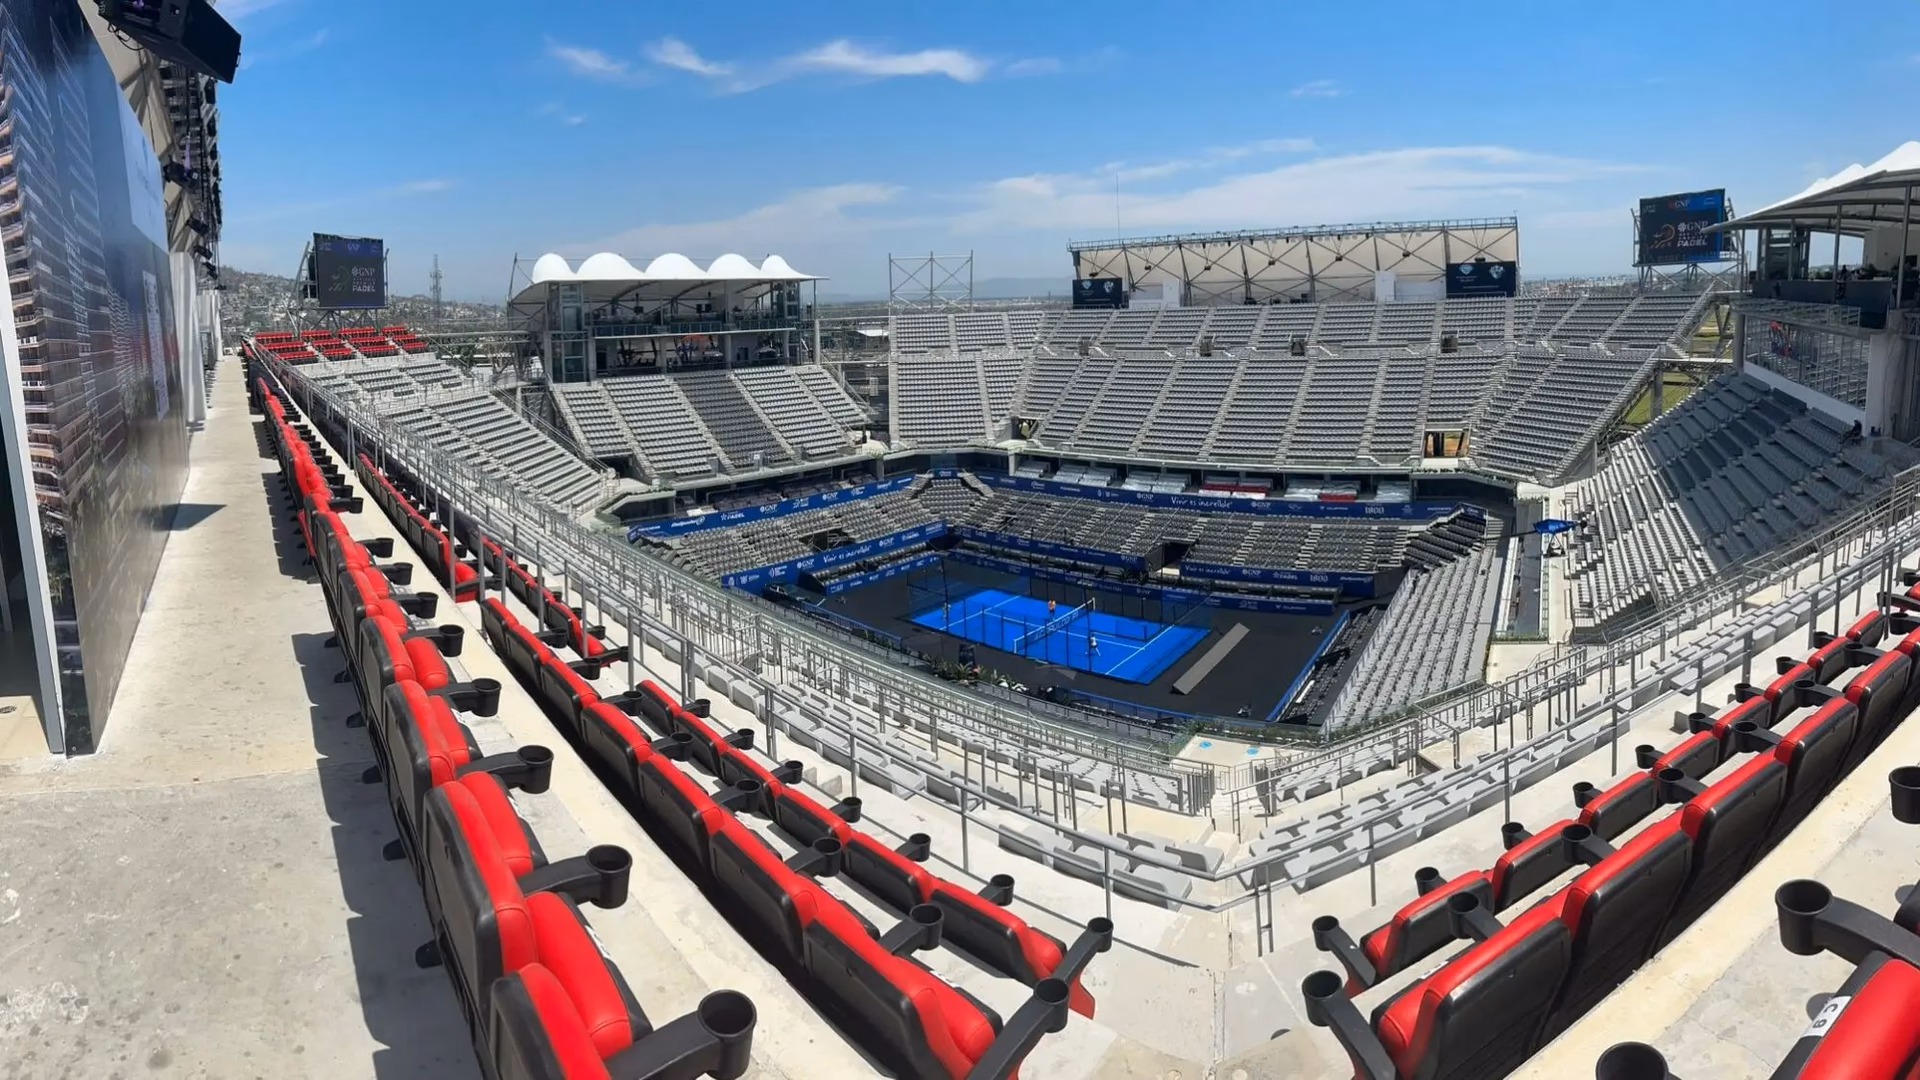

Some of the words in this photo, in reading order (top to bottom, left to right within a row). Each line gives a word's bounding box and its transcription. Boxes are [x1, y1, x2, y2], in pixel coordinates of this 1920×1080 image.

[1686, 220, 1708, 231] GNP
[1677, 238, 1707, 247] PADEL
[764, 503, 777, 511] GNP
[1365, 506, 1384, 514] 1800
[1310, 574, 1328, 582] 1800
